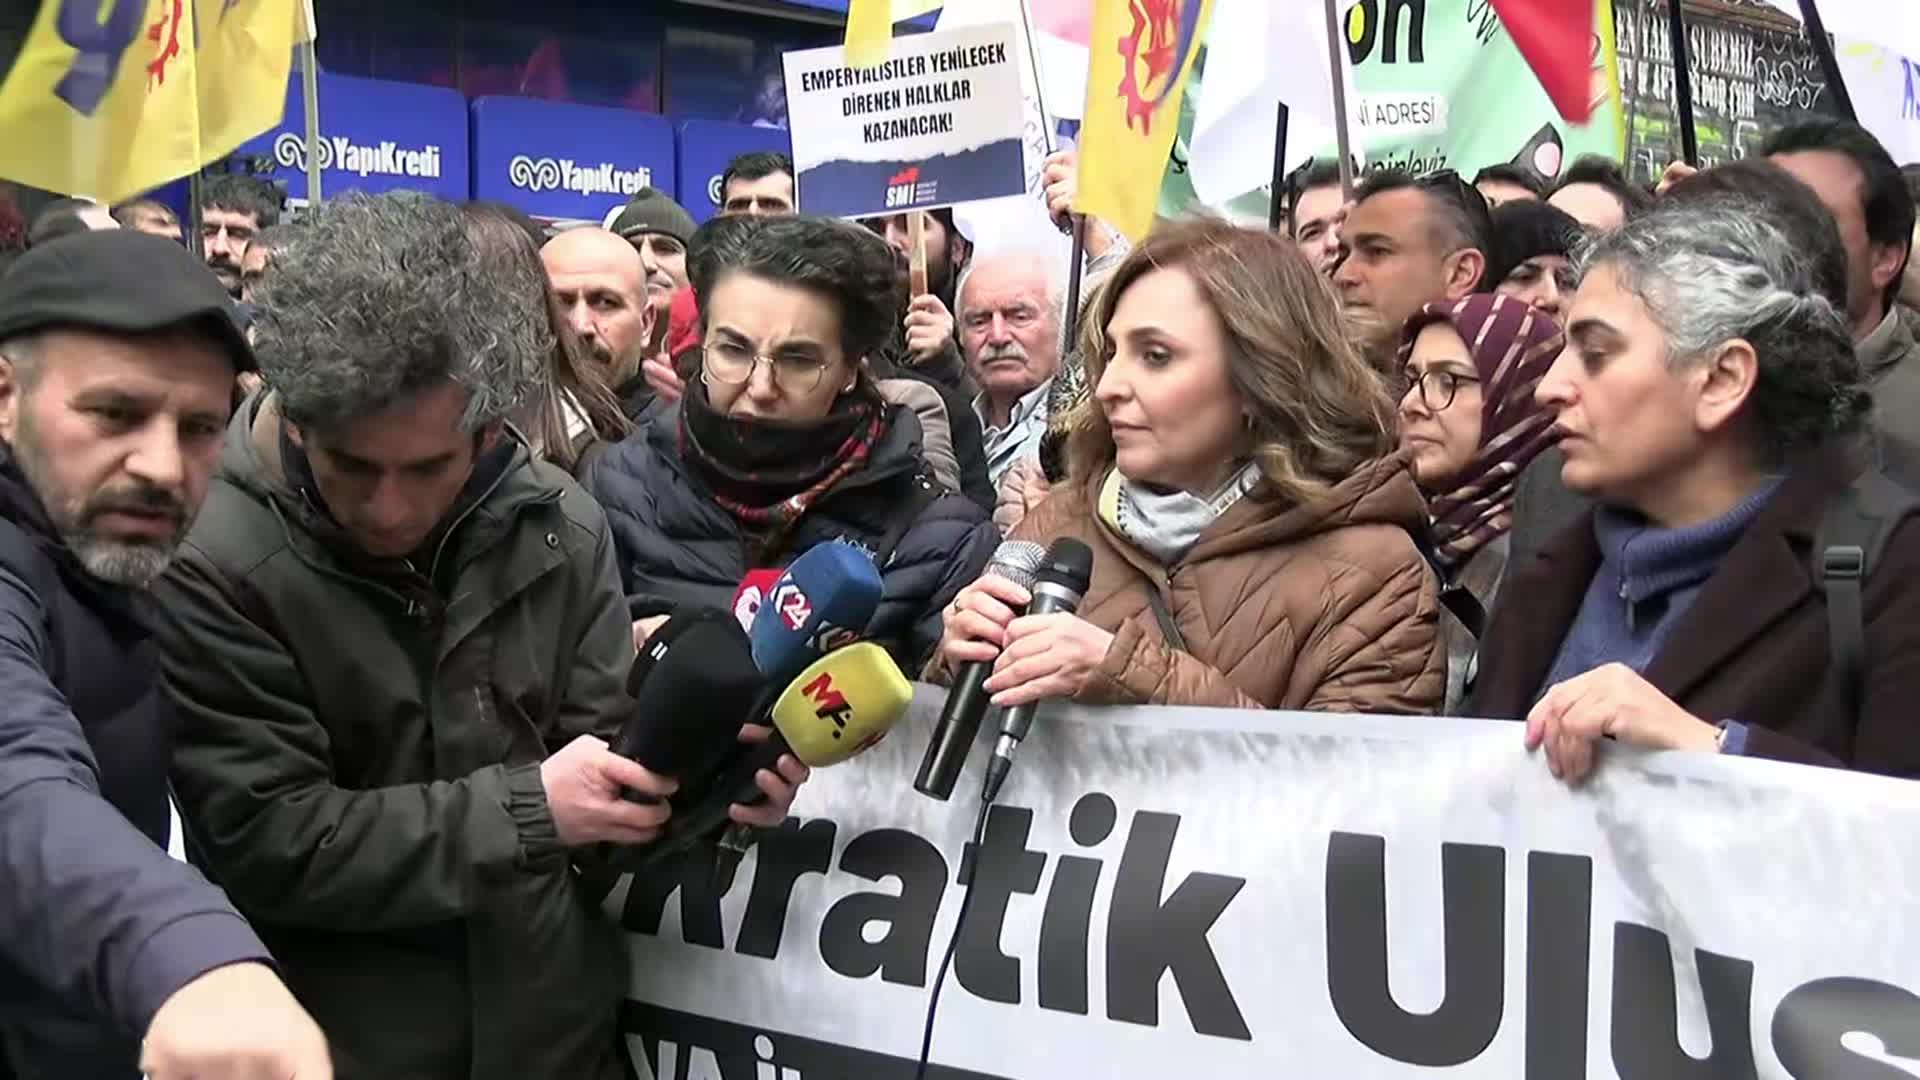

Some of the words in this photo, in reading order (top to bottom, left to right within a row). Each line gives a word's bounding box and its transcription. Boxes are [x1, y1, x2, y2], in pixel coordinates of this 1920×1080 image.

[930, 42, 1006, 73] YENİLECEK
[842, 90, 901, 117] DİRENEN
[905, 79, 971, 107] HALKLAR
[863, 112, 953, 143] KAZANACAK!
